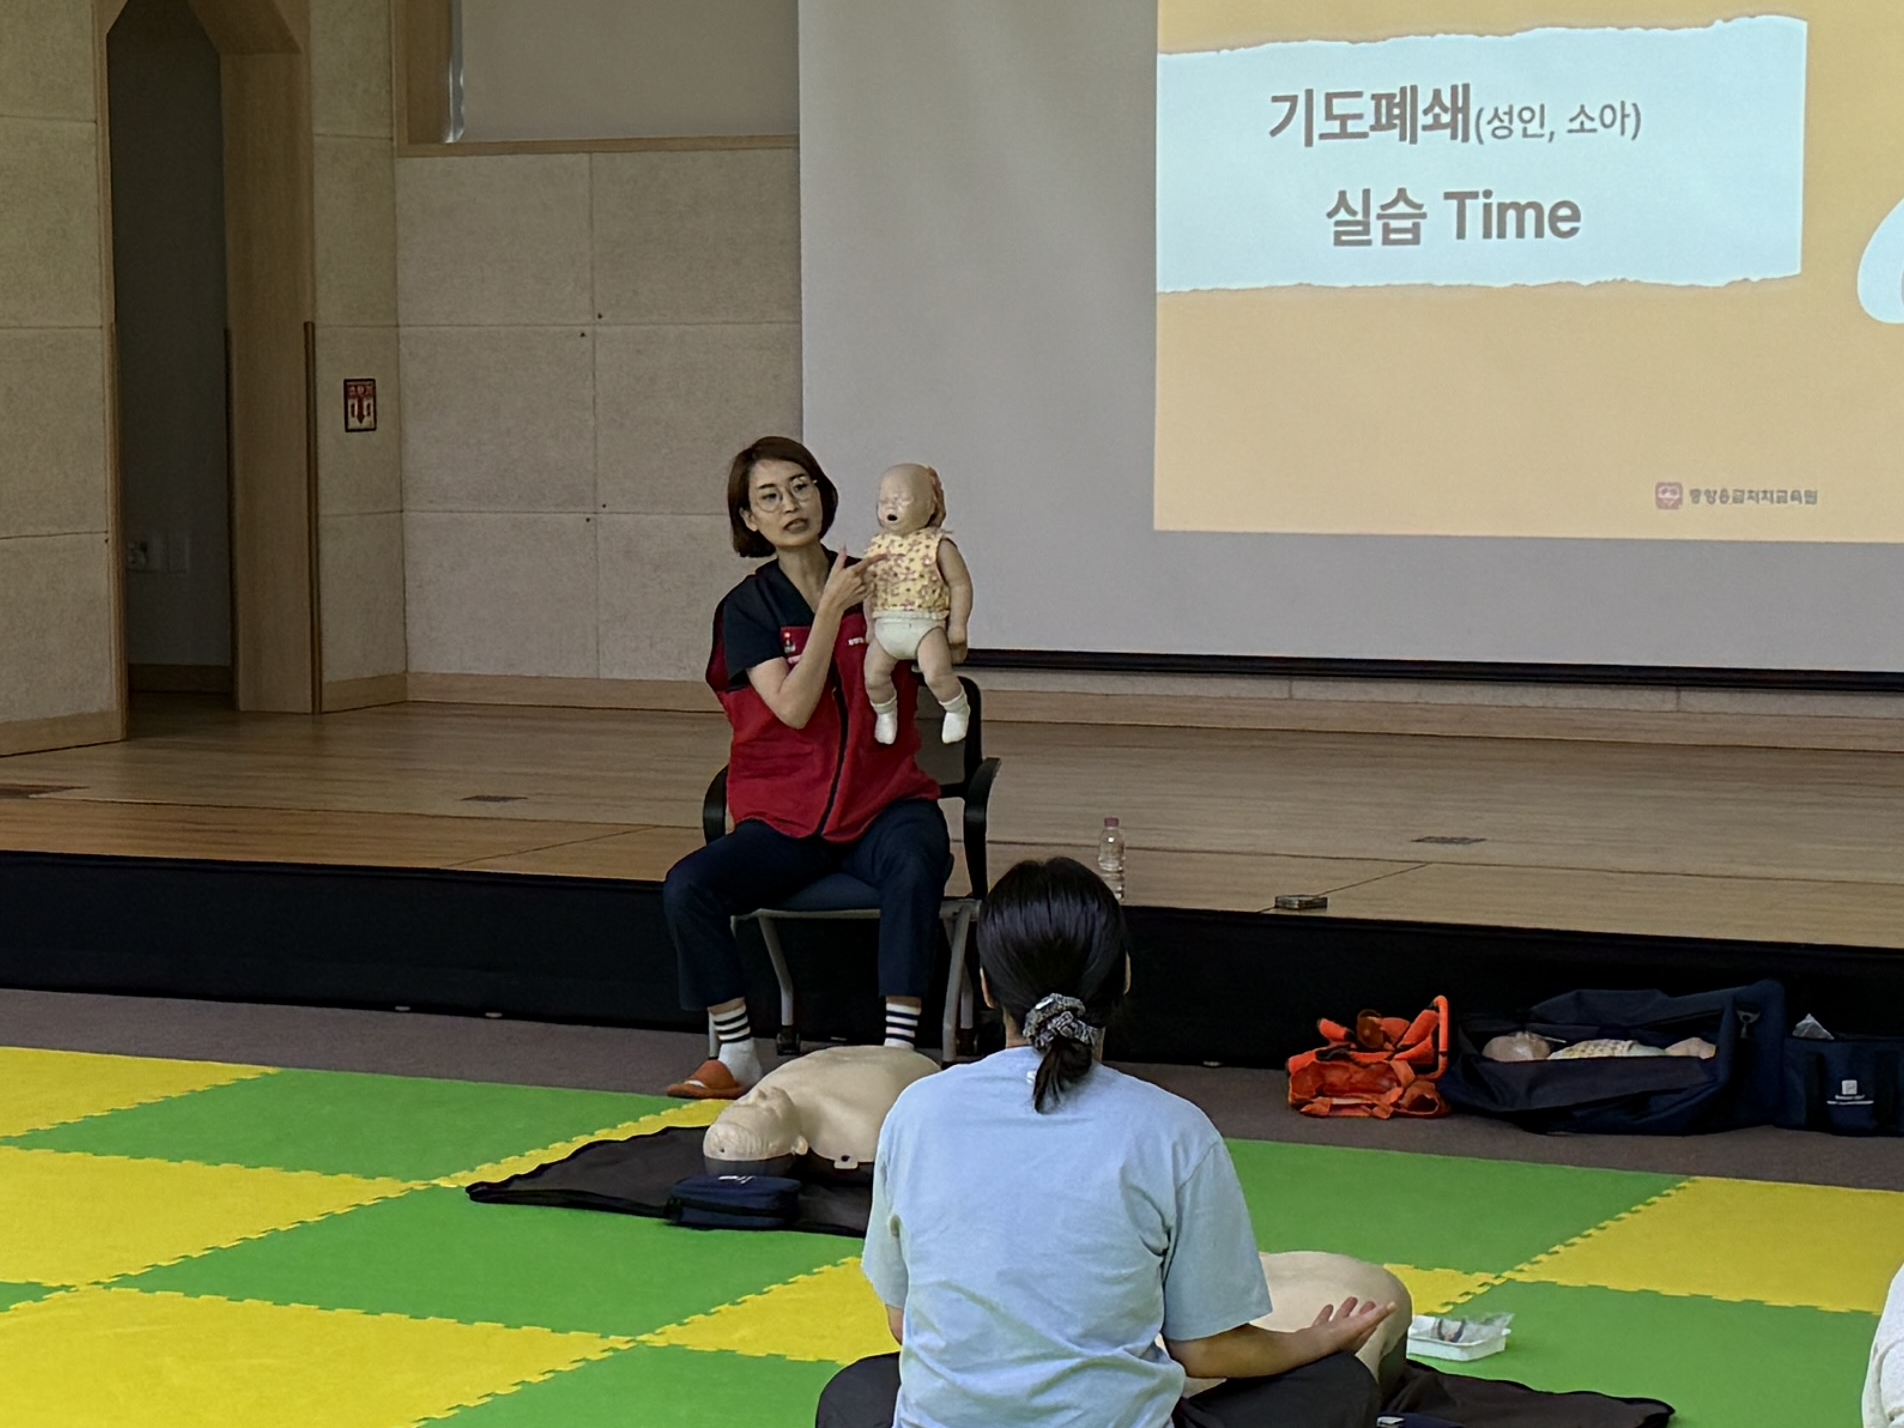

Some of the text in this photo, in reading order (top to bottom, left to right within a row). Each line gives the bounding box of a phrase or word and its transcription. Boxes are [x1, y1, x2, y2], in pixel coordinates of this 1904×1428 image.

[1268, 82, 1642, 148] 기도폐쇄(성인, 소아)
[1325, 186, 1582, 247] 실습 Time
